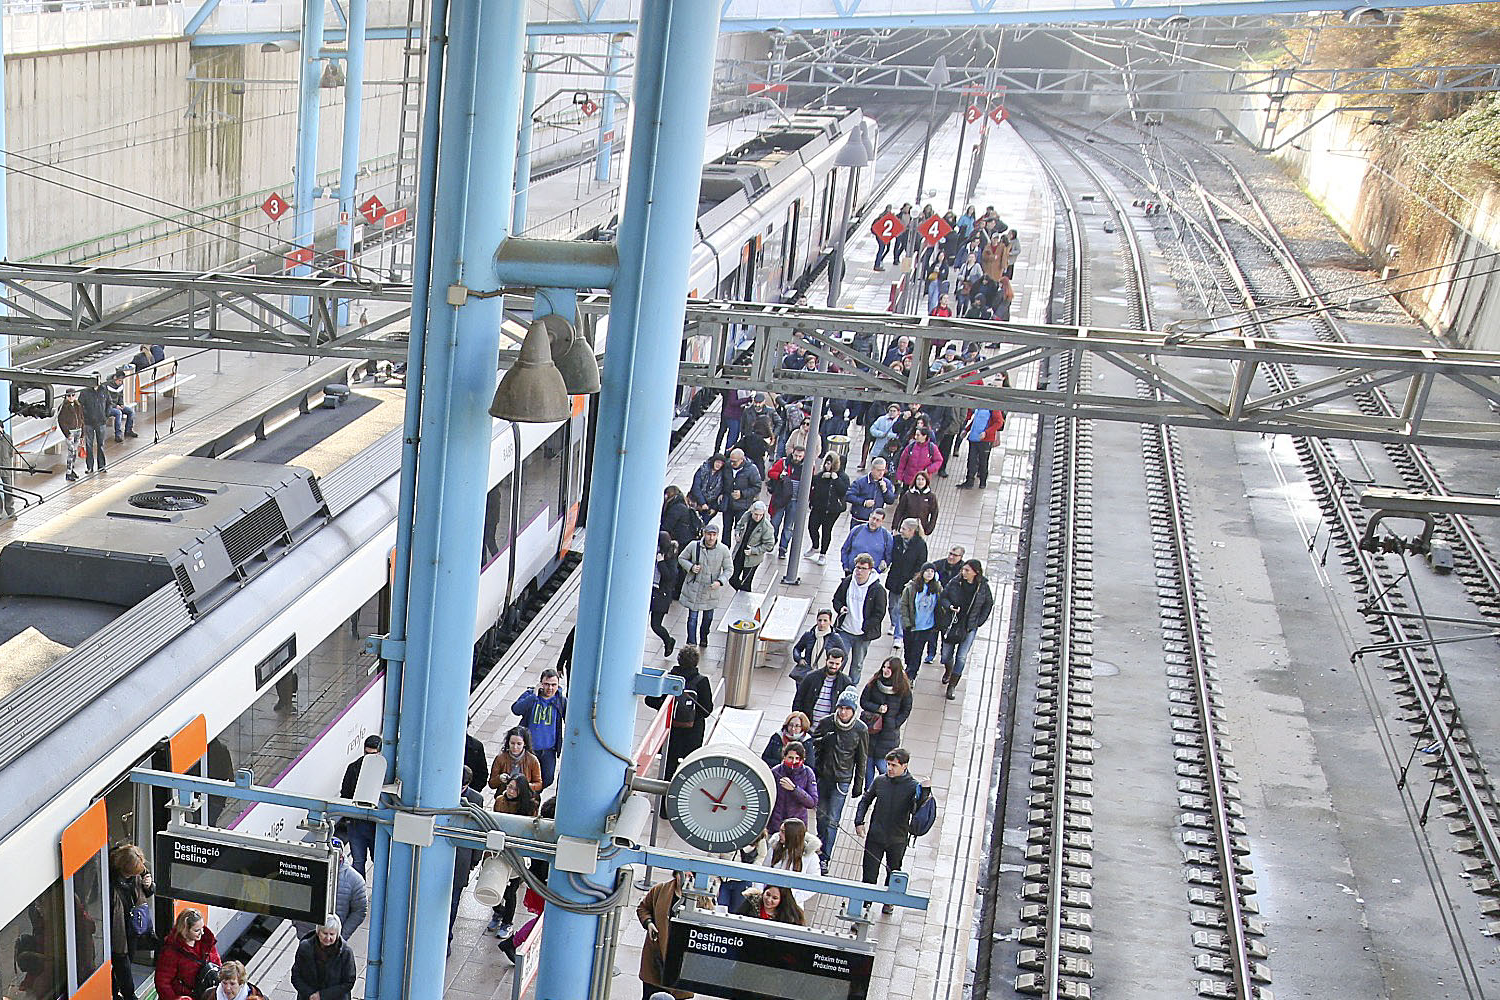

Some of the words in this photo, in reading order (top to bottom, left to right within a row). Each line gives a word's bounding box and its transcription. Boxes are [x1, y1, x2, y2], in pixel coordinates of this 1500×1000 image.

[968, 110, 976, 120] 2
[995, 110, 1002, 120] 4
[270, 199, 279, 214] 3
[371, 202, 377, 217] 1
[882, 220, 893, 236] 2
[928, 221, 939, 237] 4
[174, 841, 220, 857] Destinació
[174, 850, 208, 864] Destino
[297, 864, 308, 872] tren
[689, 929, 744, 947] Destinació
[688, 939, 727, 954] Destino
[835, 957, 848, 965] tren
[837, 965, 850, 973] tren
